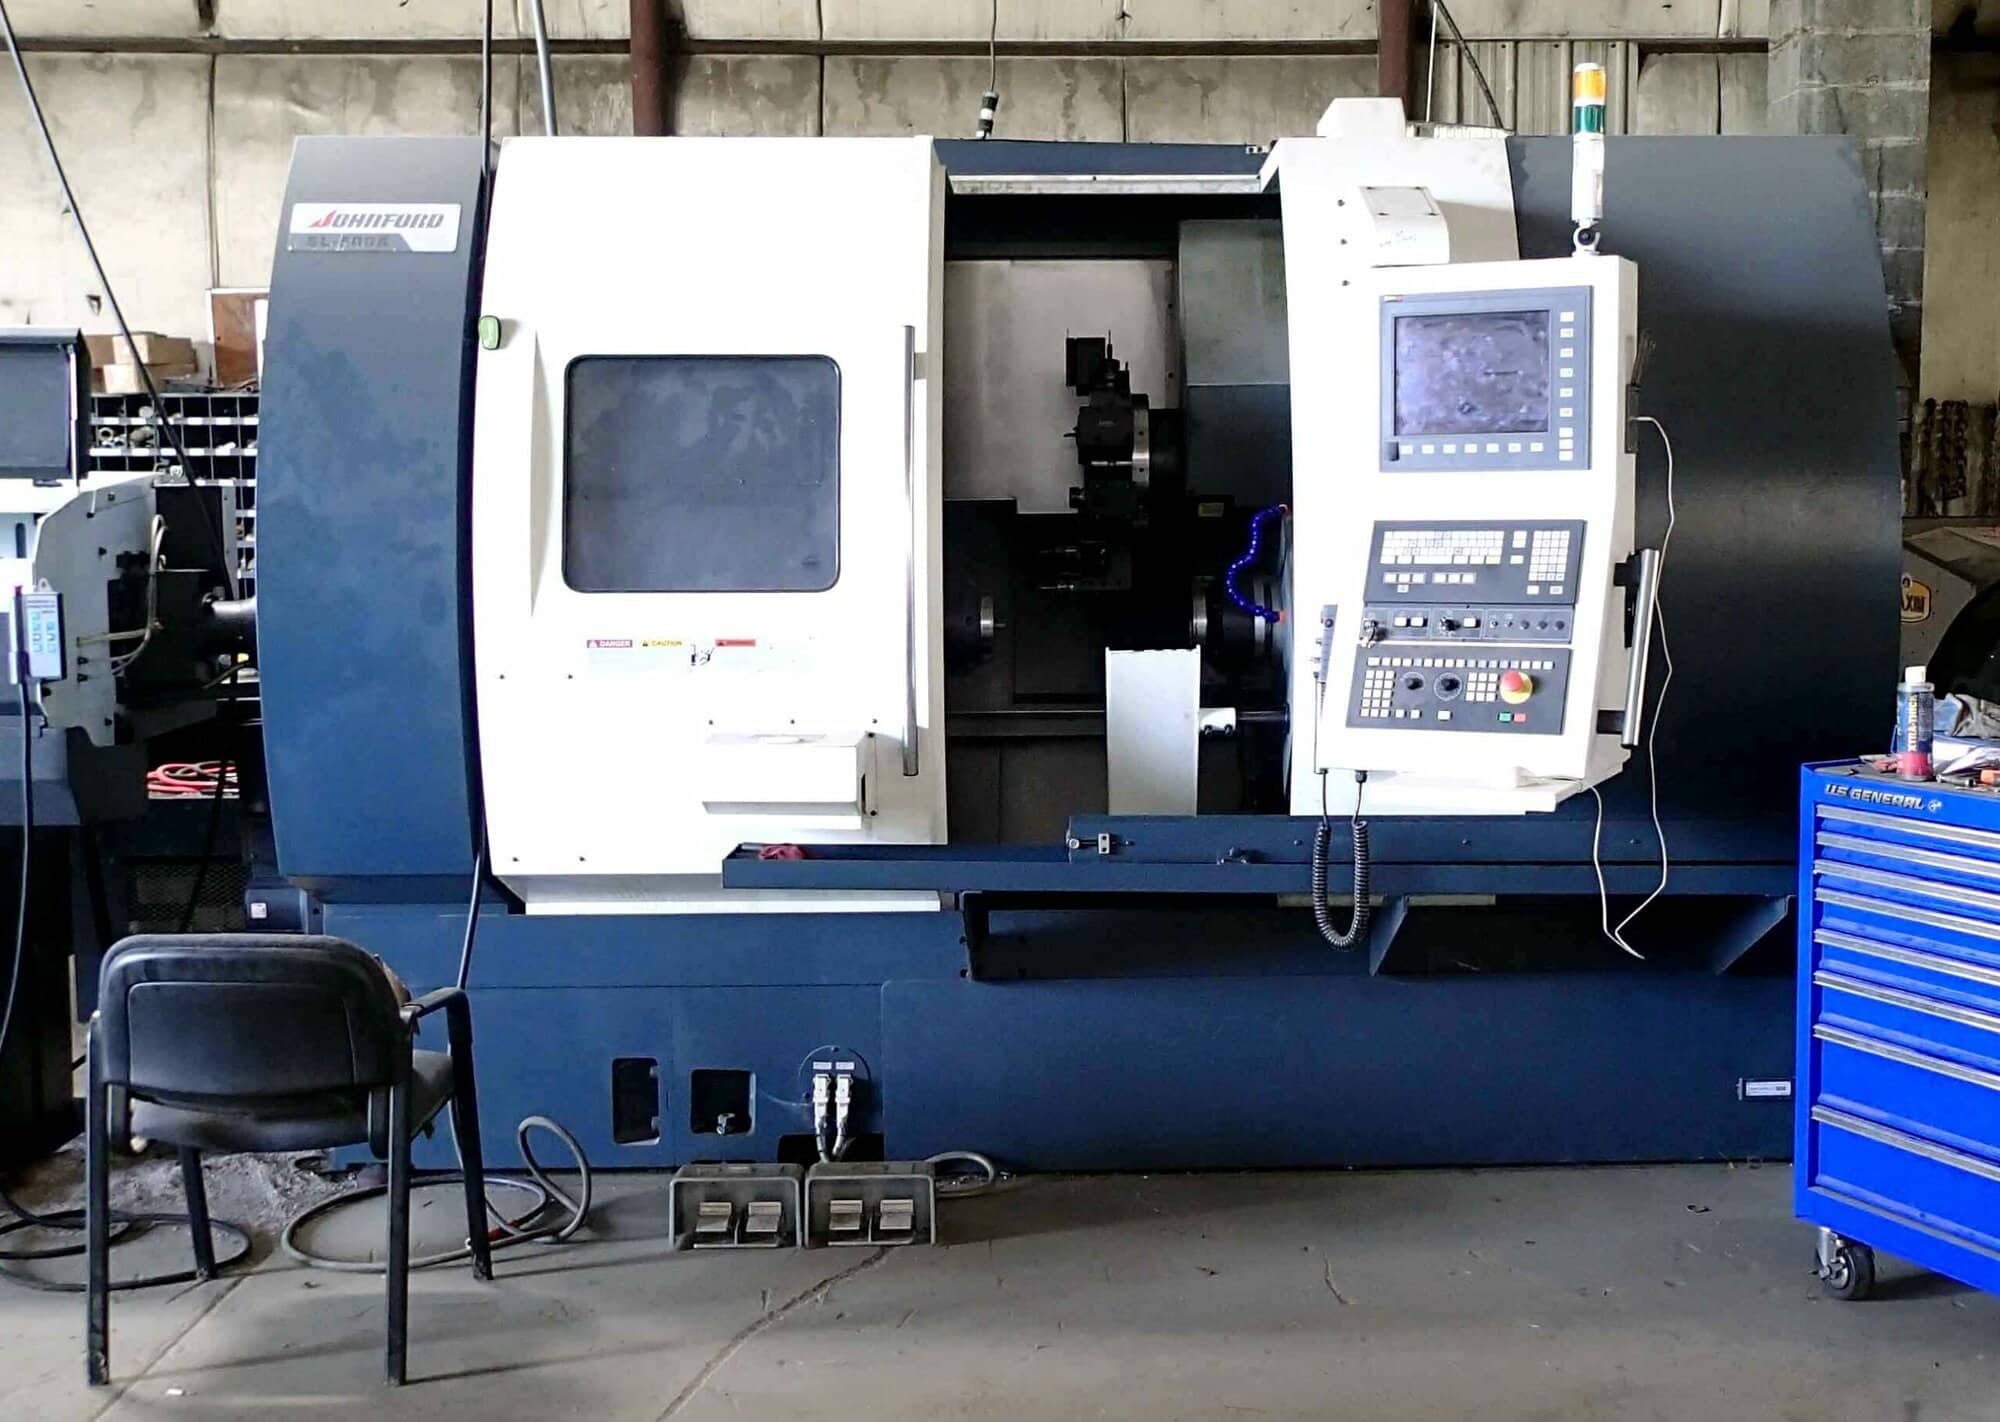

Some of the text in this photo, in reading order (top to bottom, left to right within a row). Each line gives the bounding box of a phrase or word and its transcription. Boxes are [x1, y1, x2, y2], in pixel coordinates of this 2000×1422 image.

[309, 210, 444, 228] JOHNFORD
[599, 640, 631, 648] DANGER
[651, 639, 683, 647] CAUTION
[1850, 788, 1925, 810] GENERAL
